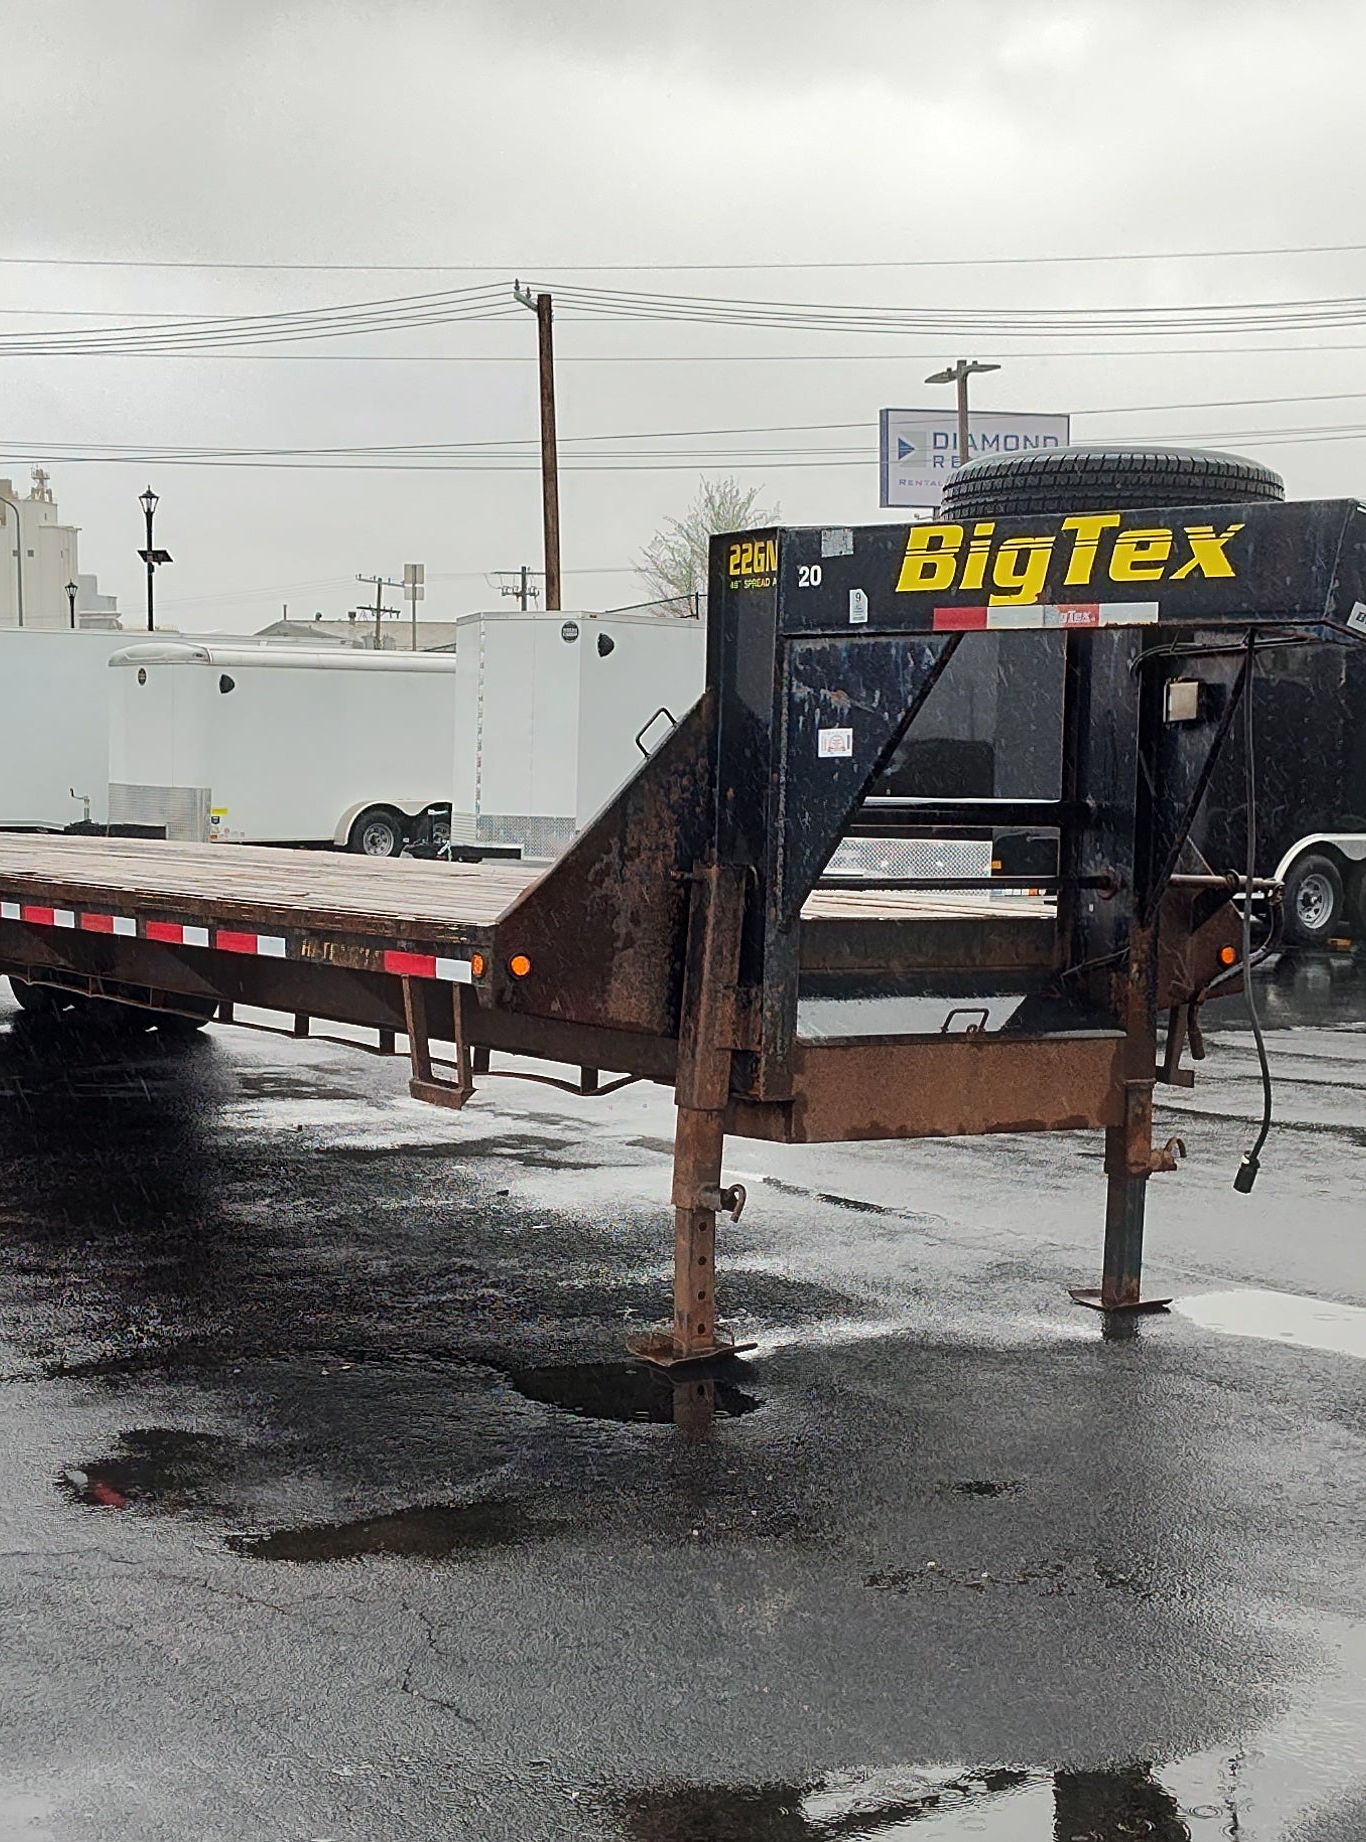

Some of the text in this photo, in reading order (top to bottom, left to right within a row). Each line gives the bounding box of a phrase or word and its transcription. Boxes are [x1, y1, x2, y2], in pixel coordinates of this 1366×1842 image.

[933, 432, 1059, 451] DIAMOND
[729, 540, 777, 575] 22GN
[895, 514, 1246, 606] BigTex
[743, 577, 770, 589] SPREAD
[798, 565, 822, 588] 20
[855, 592, 862, 602] 9
